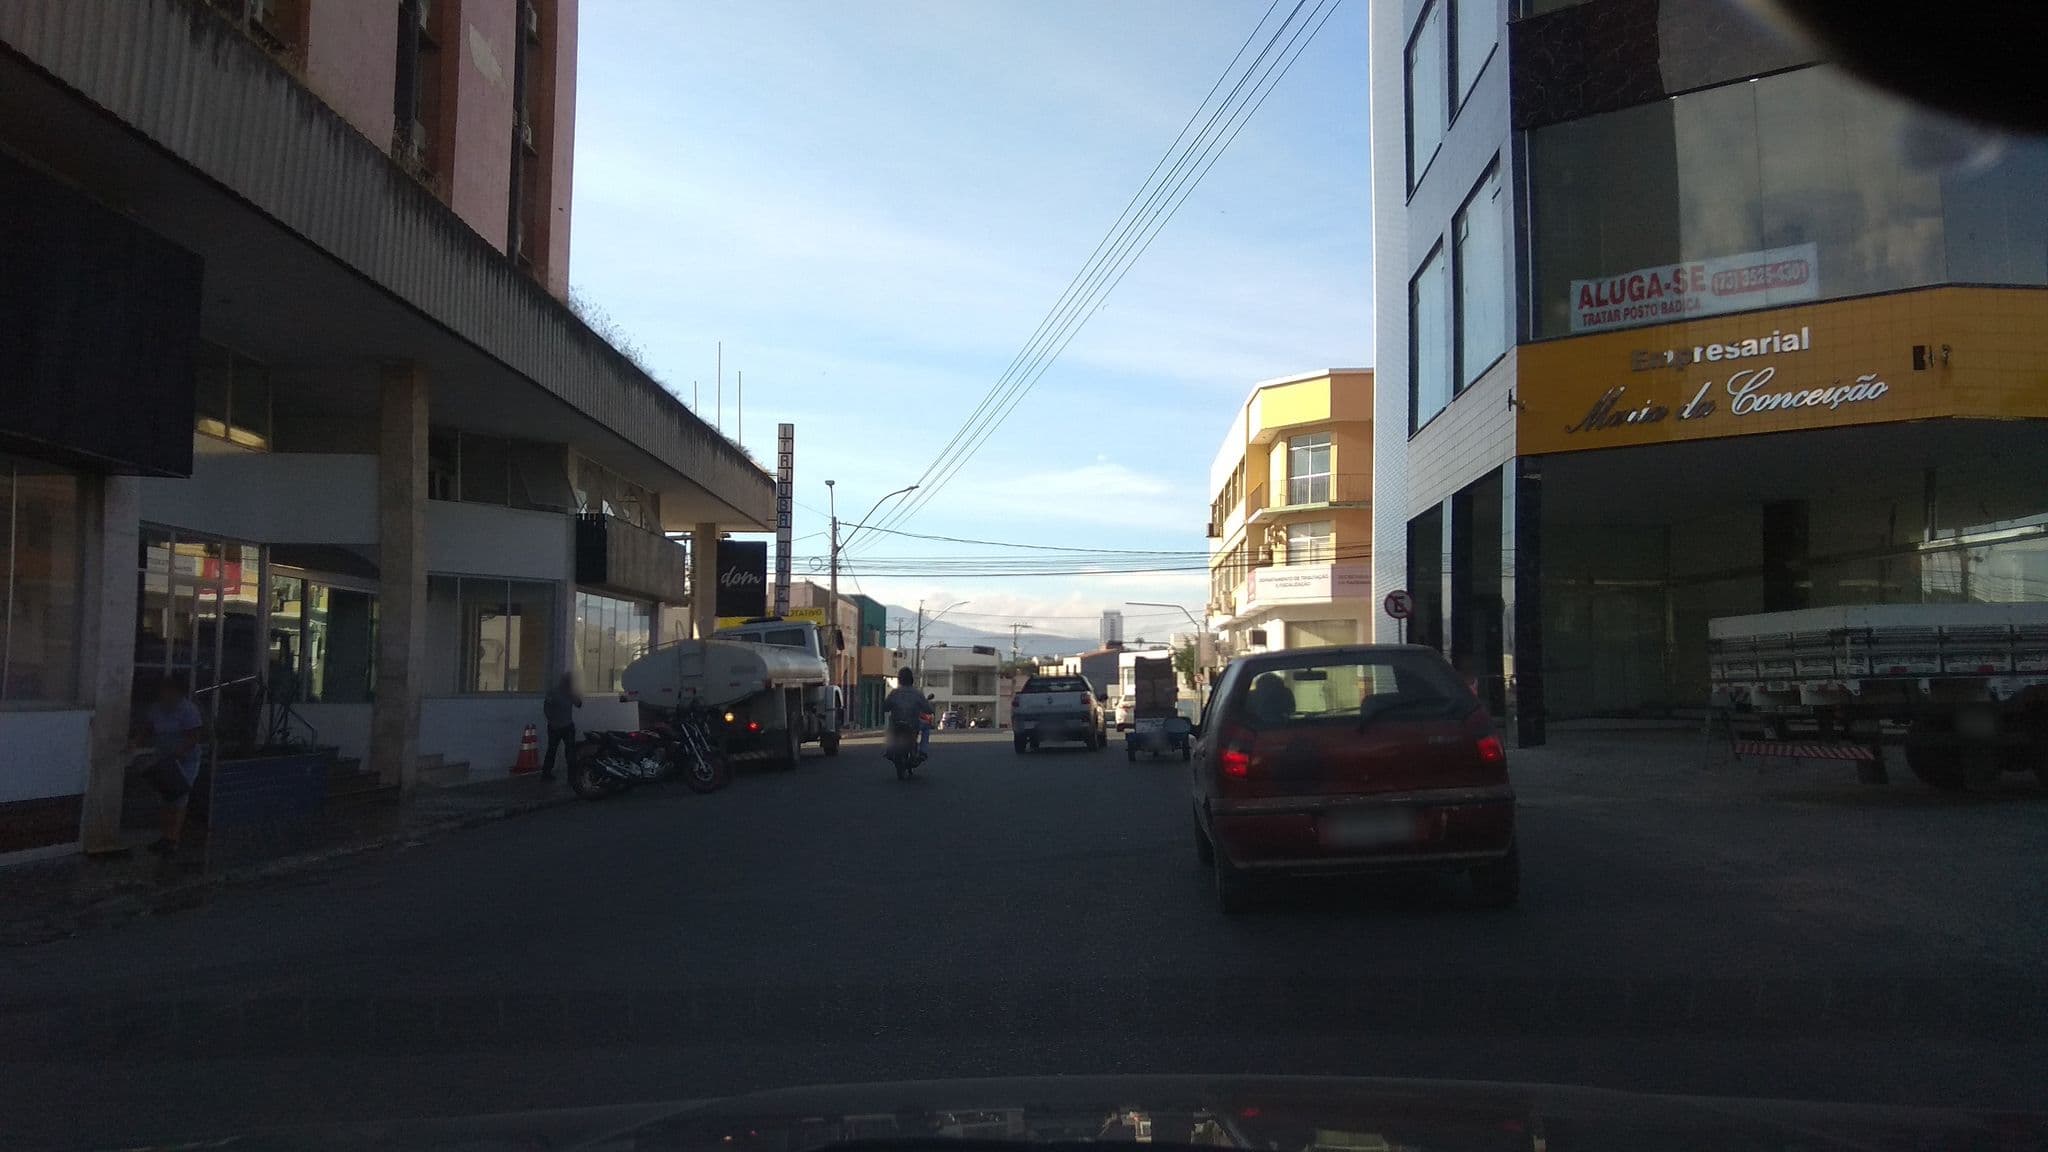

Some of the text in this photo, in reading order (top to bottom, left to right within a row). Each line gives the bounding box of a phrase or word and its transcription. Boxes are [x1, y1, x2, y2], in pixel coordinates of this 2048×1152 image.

[1577, 265, 1706, 310] ALUGA-SE
[1582, 308, 1622, 327] TRATAR
[1623, 303, 1657, 320] POSTO
[1631, 326, 1812, 372] Empresarial
[1726, 366, 1889, 416] Conceição
[720, 565, 763, 588] dom
